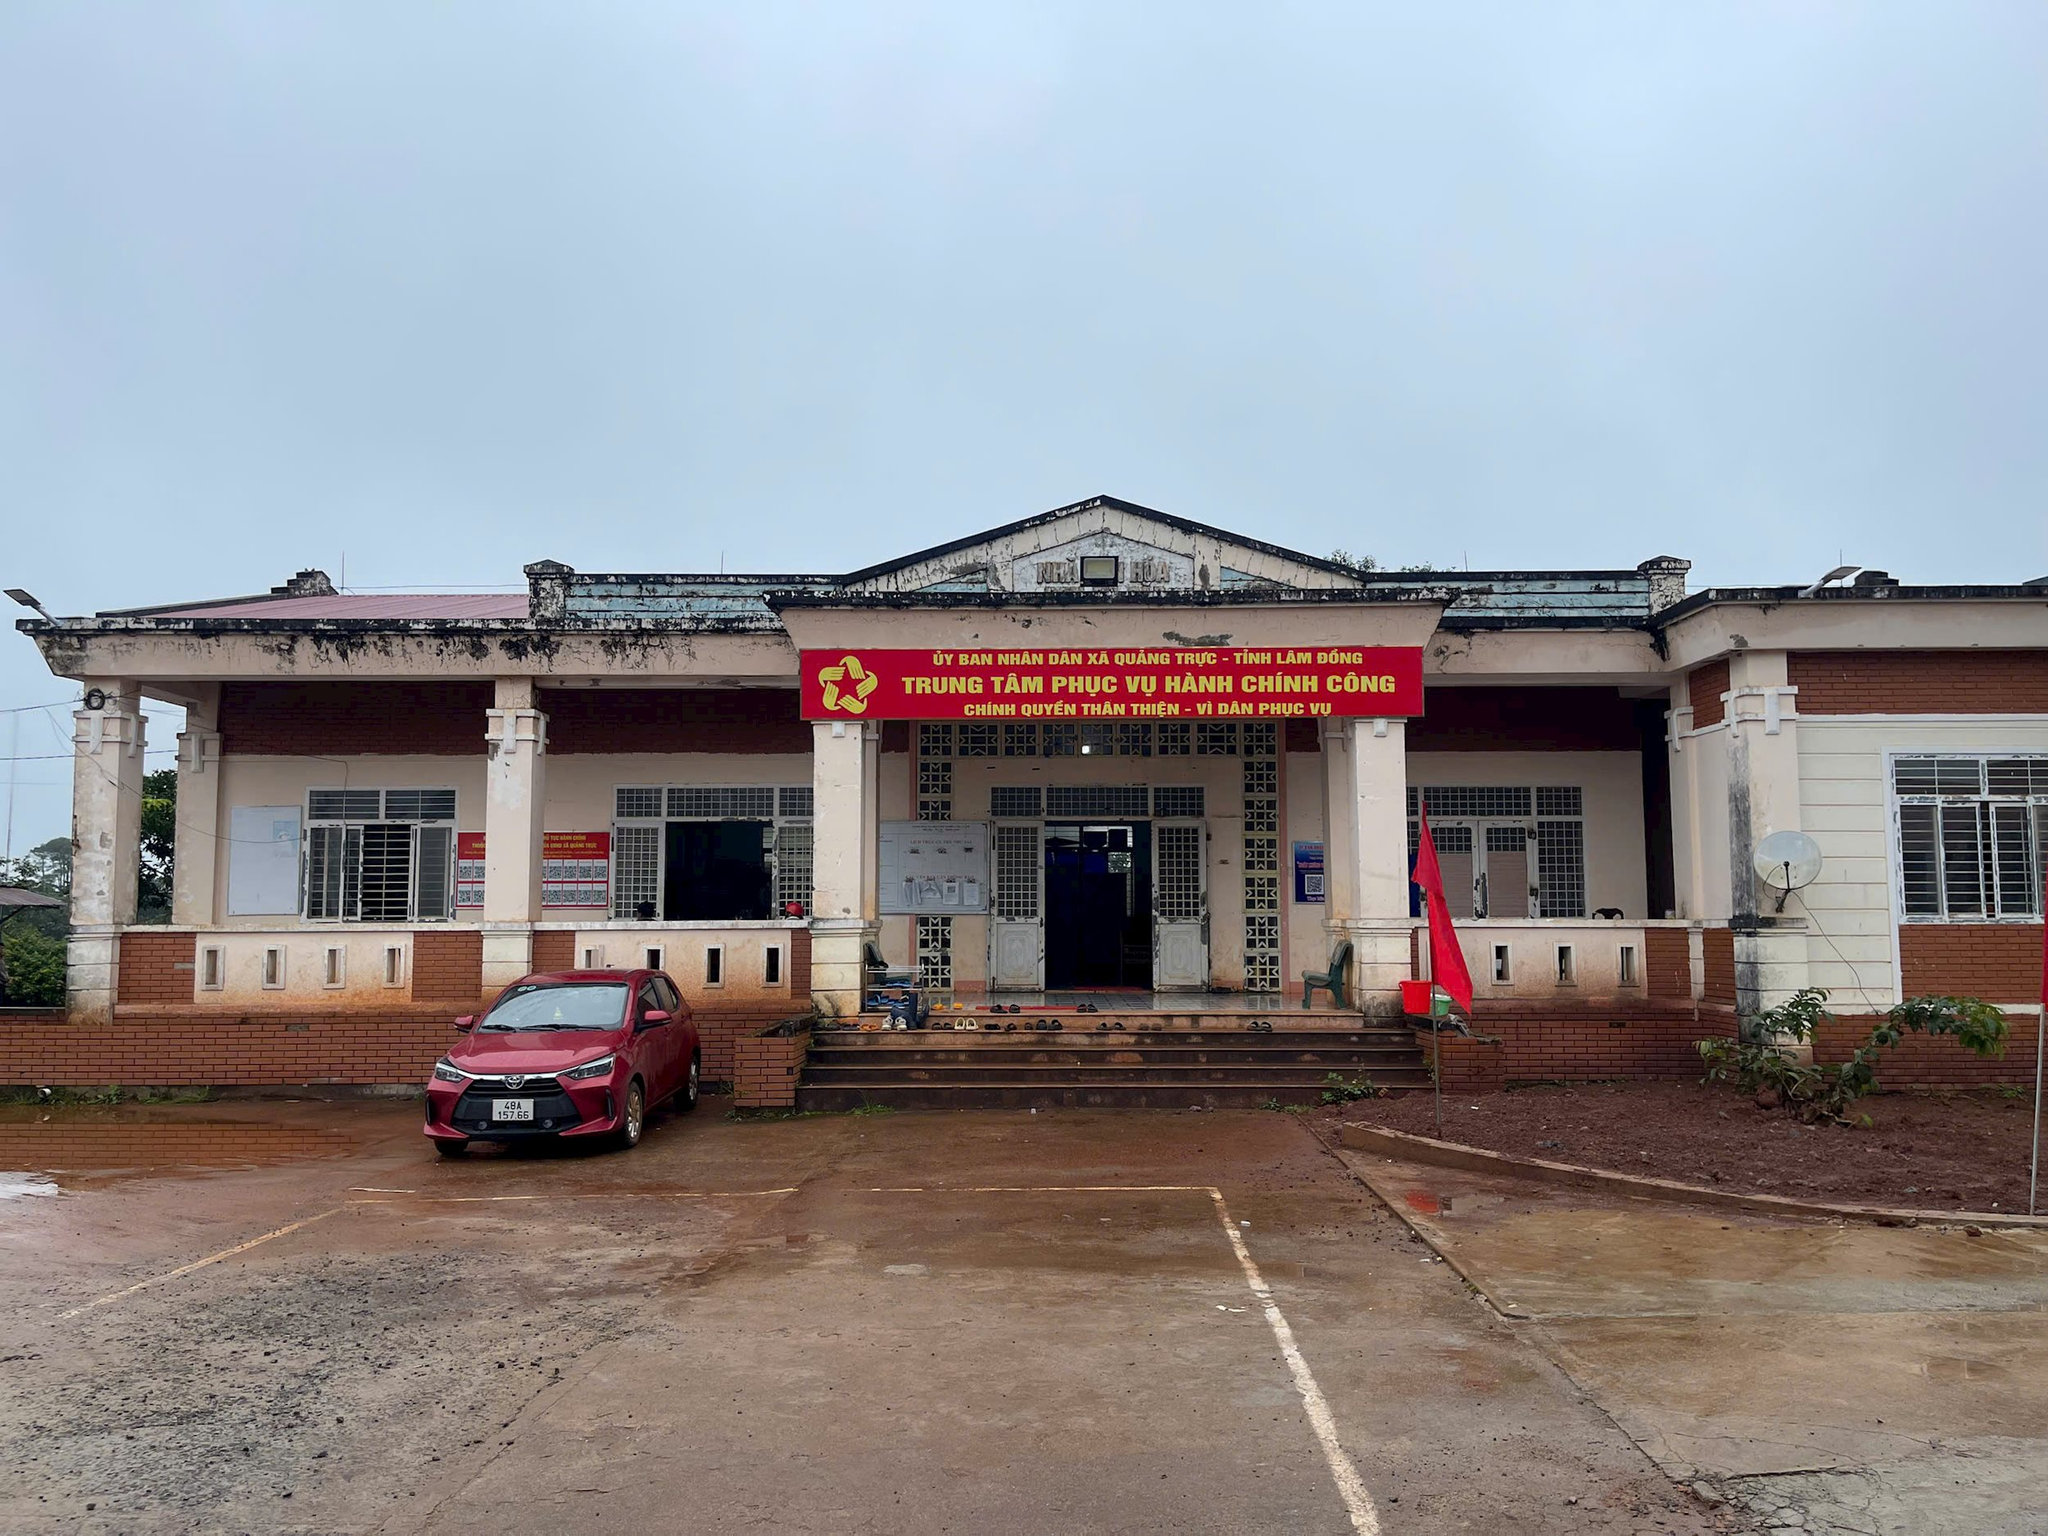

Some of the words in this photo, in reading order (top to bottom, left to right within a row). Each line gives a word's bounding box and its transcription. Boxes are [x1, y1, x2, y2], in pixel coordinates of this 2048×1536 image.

[933, 651, 953, 665] ỦY
[959, 653, 992, 665] BAN
[997, 651, 1043, 665] NHÂN
[1048, 651, 1082, 665] DÂN
[1087, 651, 1110, 665] XÃ
[1114, 650, 1170, 665] QUẢNG
[1175, 652, 1217, 666] TRỰC
[1234, 649, 1271, 665] TỈNH
[1276, 650, 1312, 665] LÂM
[1317, 649, 1363, 665] ĐỒNG
[902, 676, 983, 694] TRUNG
[991, 673, 1043, 694] TÂM
[1052, 676, 1117, 697] PHỤC
[1125, 676, 1157, 697] VỤ
[1165, 672, 1232, 693] HÀNH
[1241, 672, 1318, 693] CHÍNH
[1326, 672, 1396, 693] CÔNG
[964, 701, 1015, 716] CHÍNH
[1021, 700, 1077, 716] QUYỀN
[1081, 701, 1125, 715] THÂN
[1130, 702, 1180, 717] THIỆN
[1196, 701, 1213, 715] VÌ
[1218, 701, 1253, 715] DÂN
[1259, 702, 1305, 717] PHỤC
[1310, 702, 1332, 717] VỤ
[504, 1101, 522, 1110] 48A
[498, 1111, 529, 1120] 157.66
